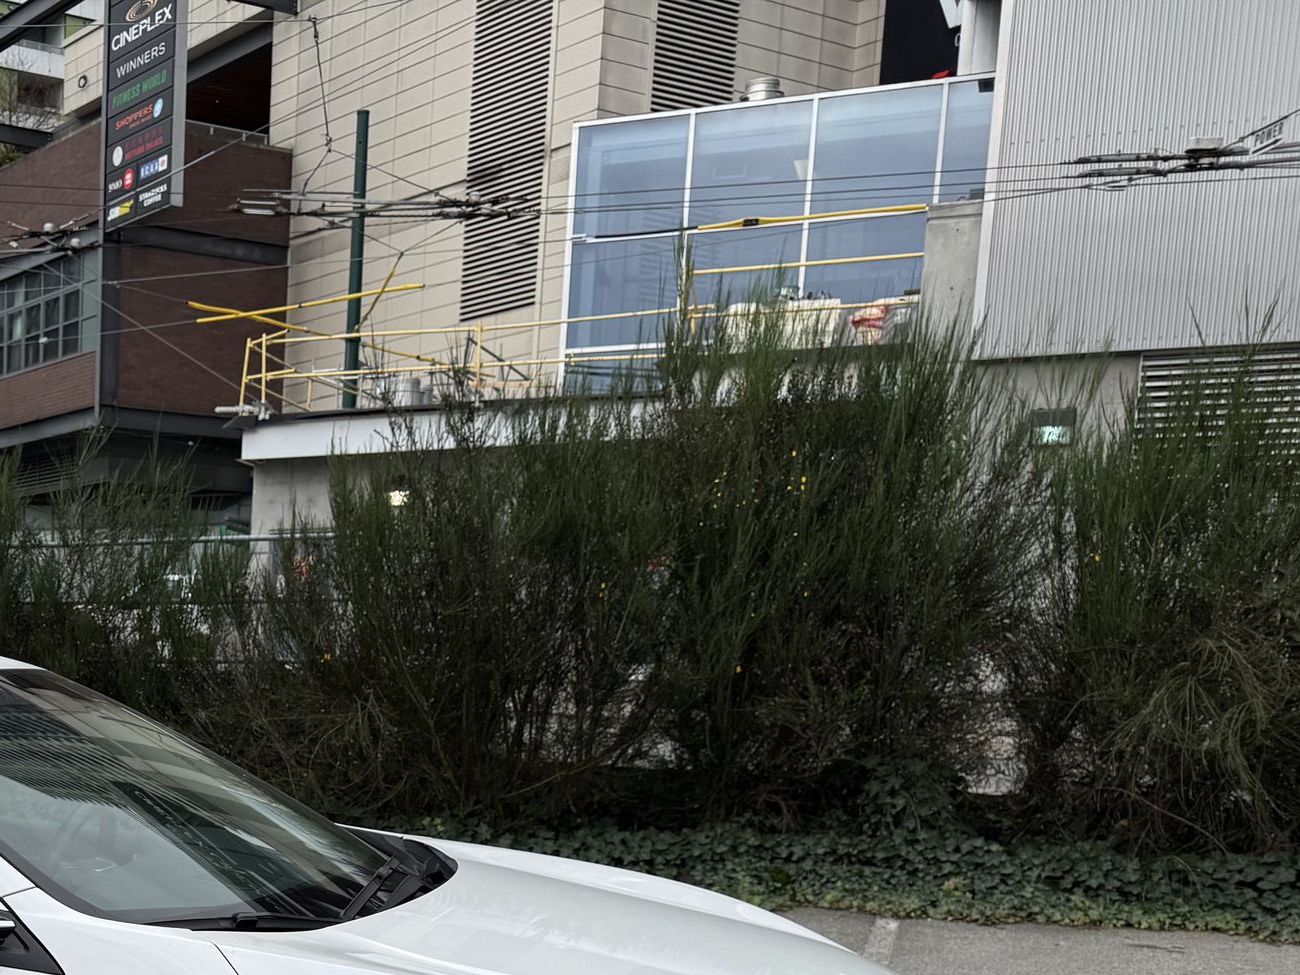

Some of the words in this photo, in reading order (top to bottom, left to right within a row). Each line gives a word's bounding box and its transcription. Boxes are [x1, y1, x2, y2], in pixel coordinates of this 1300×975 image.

[111, 4, 173, 51] CINEPLEX
[116, 42, 166, 79] WINNERS
[112, 83, 141, 109] FITNESS
[142, 69, 167, 93] WORLD
[115, 104, 154, 130] SHOPPERS
[1254, 121, 1284, 147] POWER
